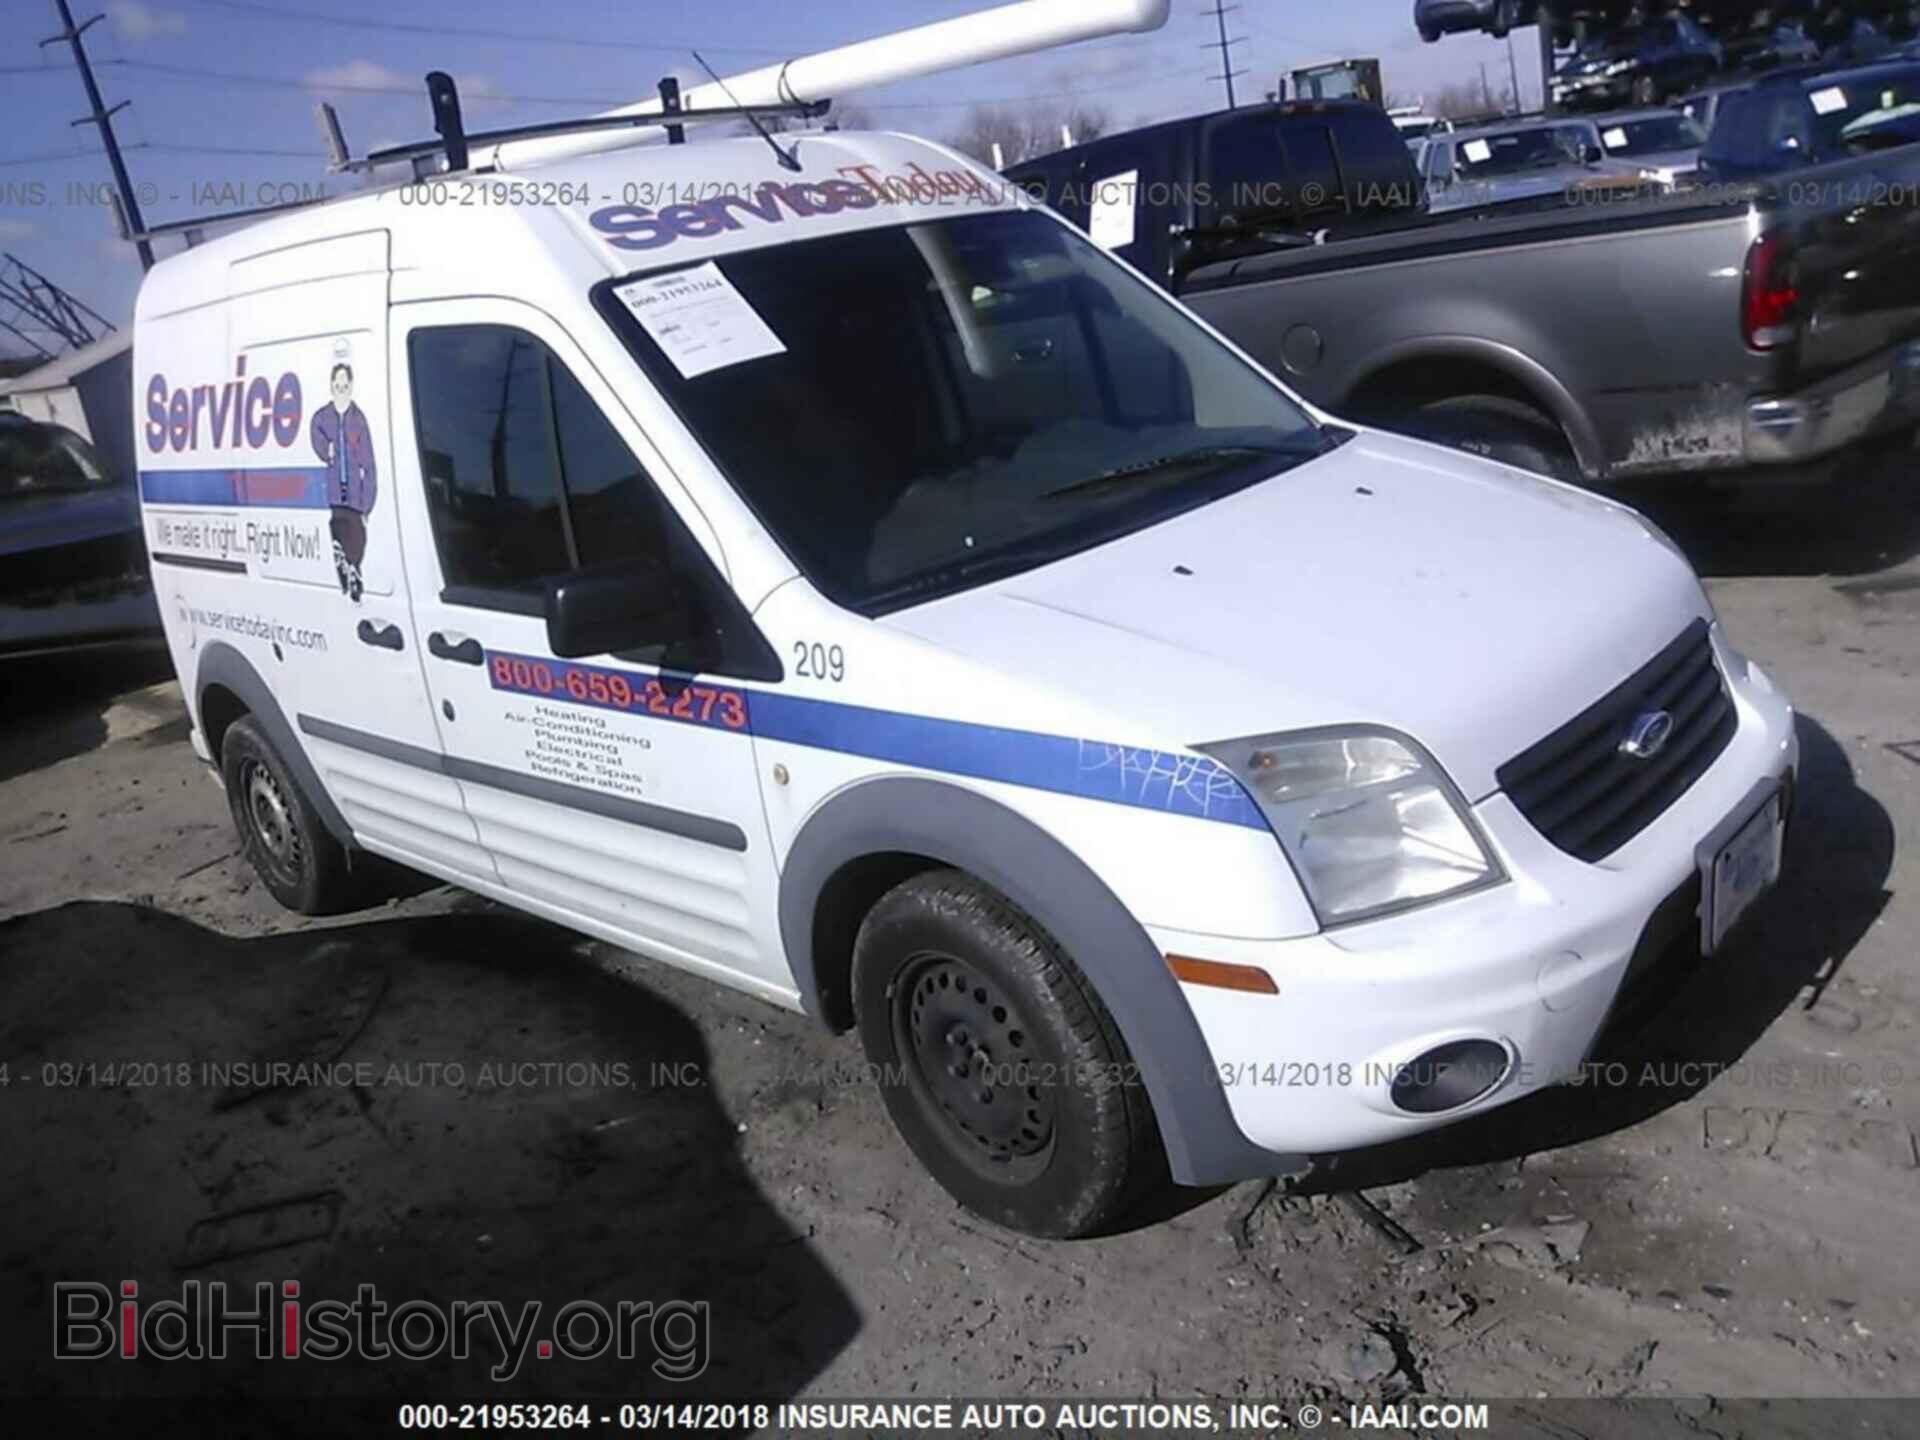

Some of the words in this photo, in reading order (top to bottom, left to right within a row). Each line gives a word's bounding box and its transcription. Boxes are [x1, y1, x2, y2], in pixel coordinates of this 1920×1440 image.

[590, 179, 878, 250] Service
[146, 355, 303, 454] Service
[174, 521, 200, 547] make
[247, 523, 281, 564] Right
[285, 524, 321, 561] Now!
[793, 641, 844, 682] 209
[494, 656, 748, 728] 800-659-2273
[504, 712, 651, 749] Air-Conditioning
[535, 705, 606, 728] Heating
[534, 729, 618, 755] Plumbing
[537, 741, 623, 766] Electrical
[525, 750, 571, 768] Pools
[596, 765, 642, 783] Spas
[531, 762, 642, 795] Refrigeration
